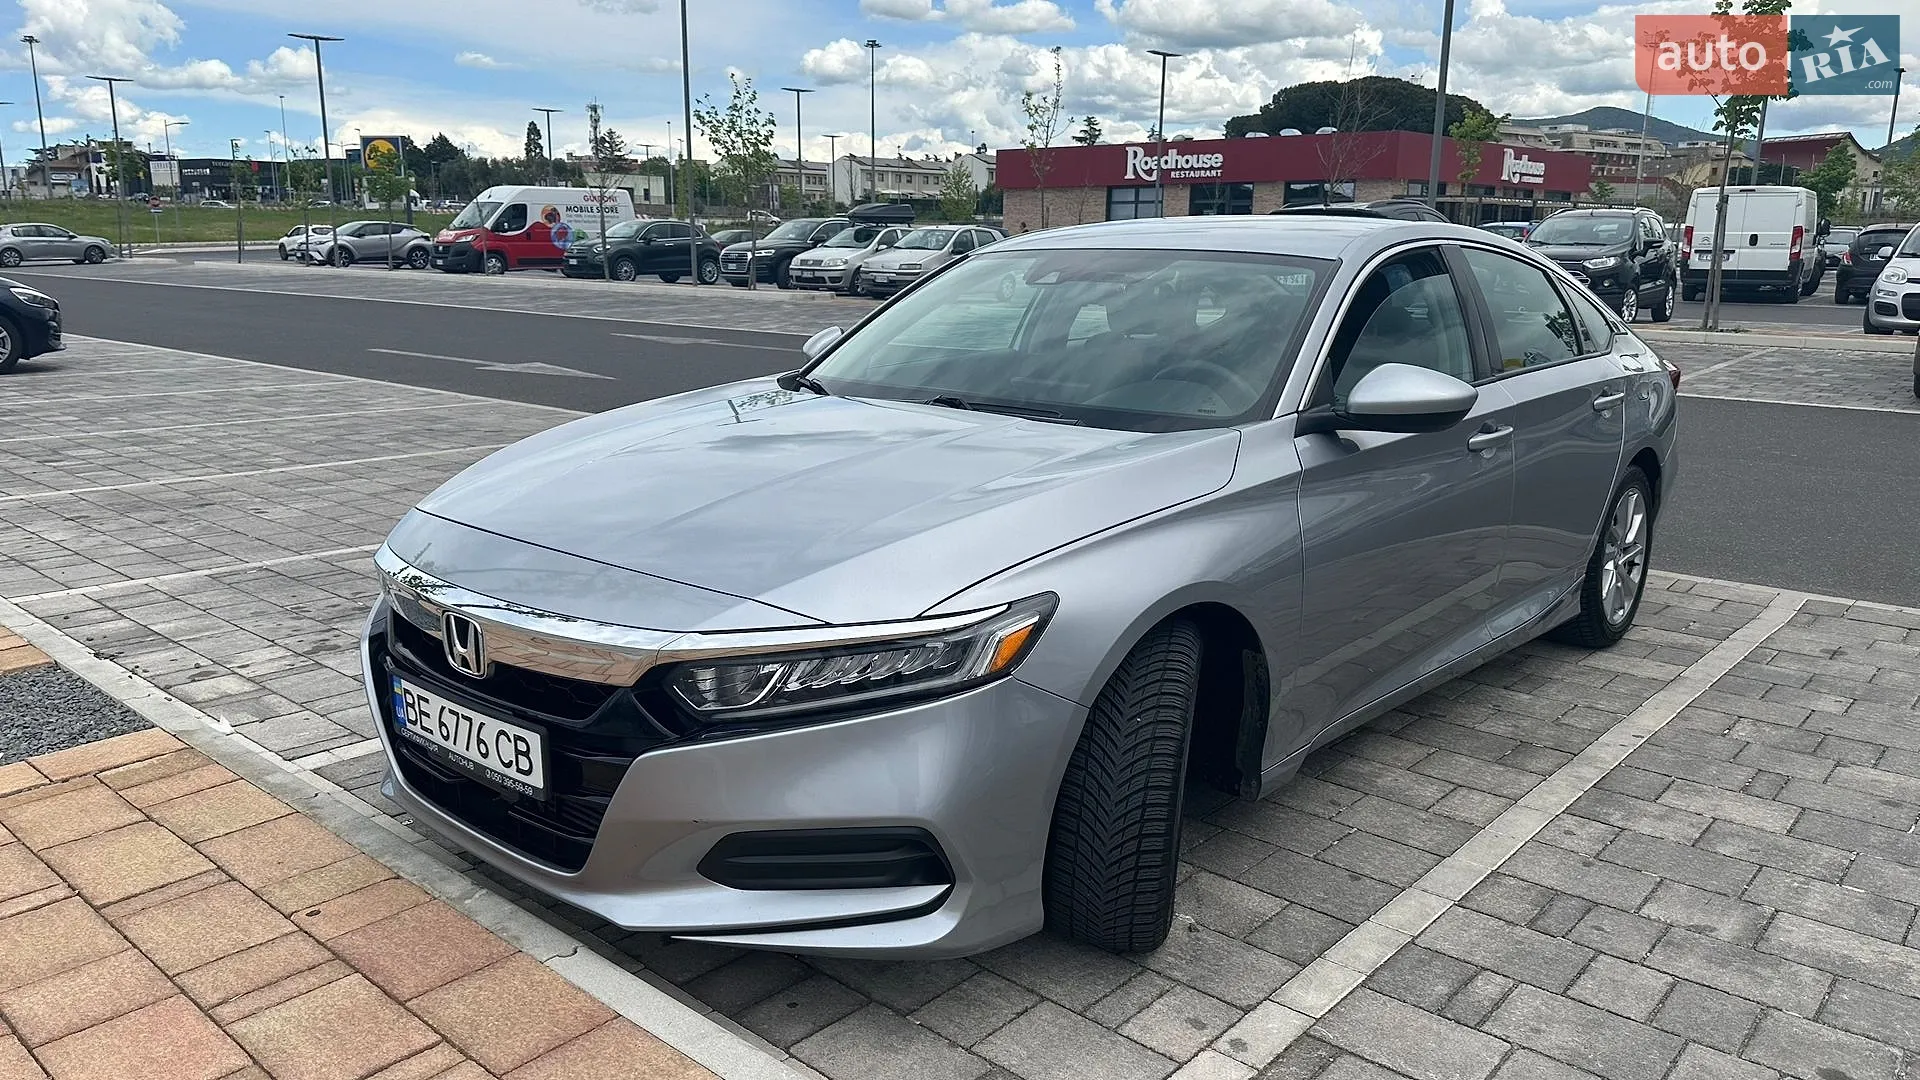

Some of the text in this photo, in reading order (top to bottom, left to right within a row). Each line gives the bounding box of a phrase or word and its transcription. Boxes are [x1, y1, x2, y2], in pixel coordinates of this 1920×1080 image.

[1124, 146, 1223, 182] Roadhouse
[1170, 169, 1223, 179] RESTAURANT
[565, 205, 594, 214] MOBILE
[403, 687, 534, 777] BE 6776 CB
[448, 751, 475, 771] AUTOHUB
